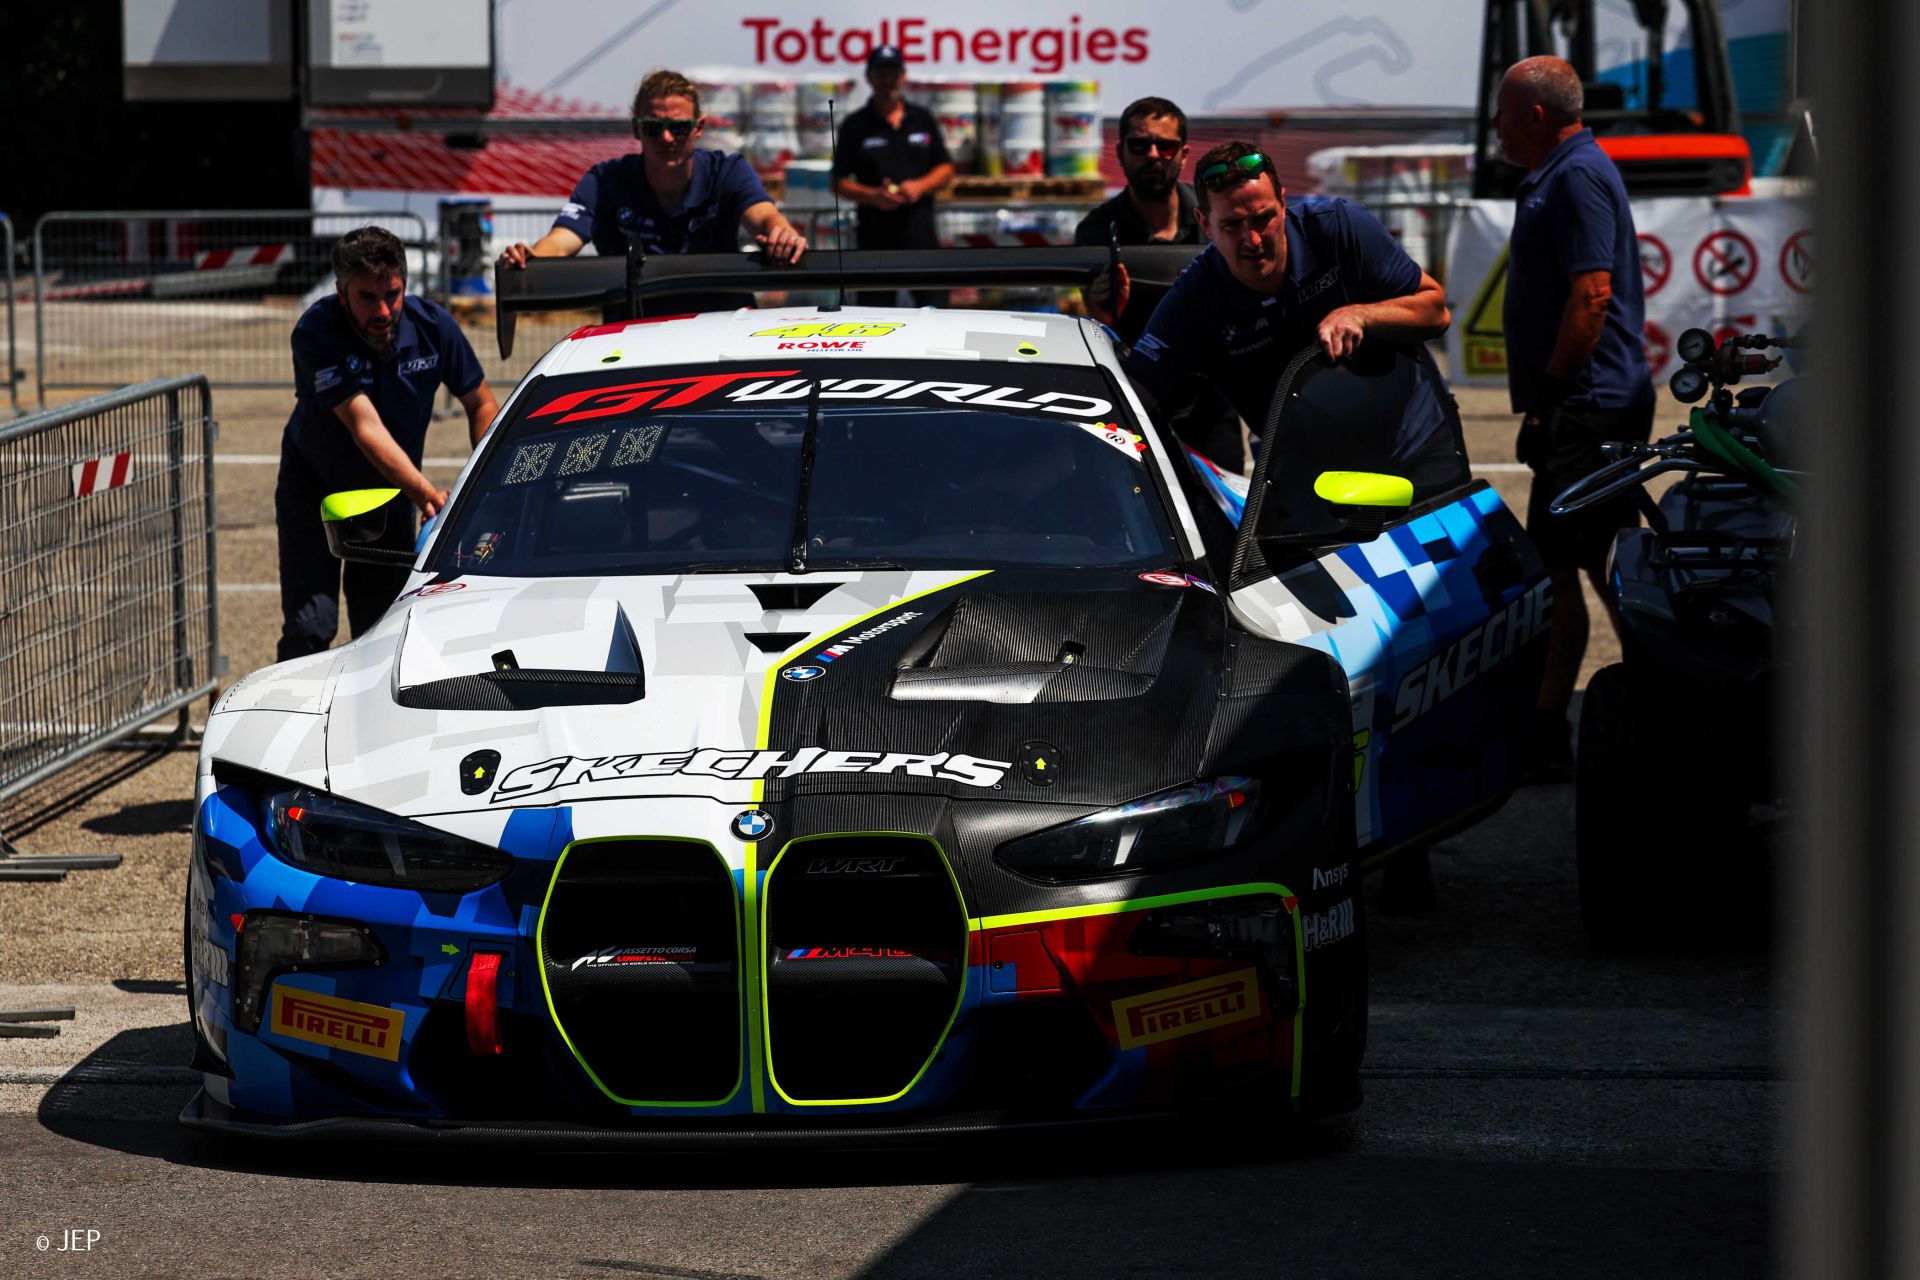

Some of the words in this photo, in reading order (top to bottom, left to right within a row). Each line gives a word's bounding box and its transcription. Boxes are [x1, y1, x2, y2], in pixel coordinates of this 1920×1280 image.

[741, 15, 1149, 74] TotalEnergies
[749, 323, 906, 339] 46
[777, 341, 866, 350] ROWE
[526, 370, 802, 425] GT
[725, 379, 1113, 417] WORLD
[842, 611, 924, 645] Motorsport
[490, 746, 1012, 803] SKECHERS
[807, 856, 907, 874] WRT
[1312, 862, 1348, 890] Ansys
[622, 947, 666, 955] ASSETTO
[666, 946, 697, 954] CORSA
[281, 995, 391, 1049] PIRELLI
[1126, 980, 1245, 1039] PIRELLI
